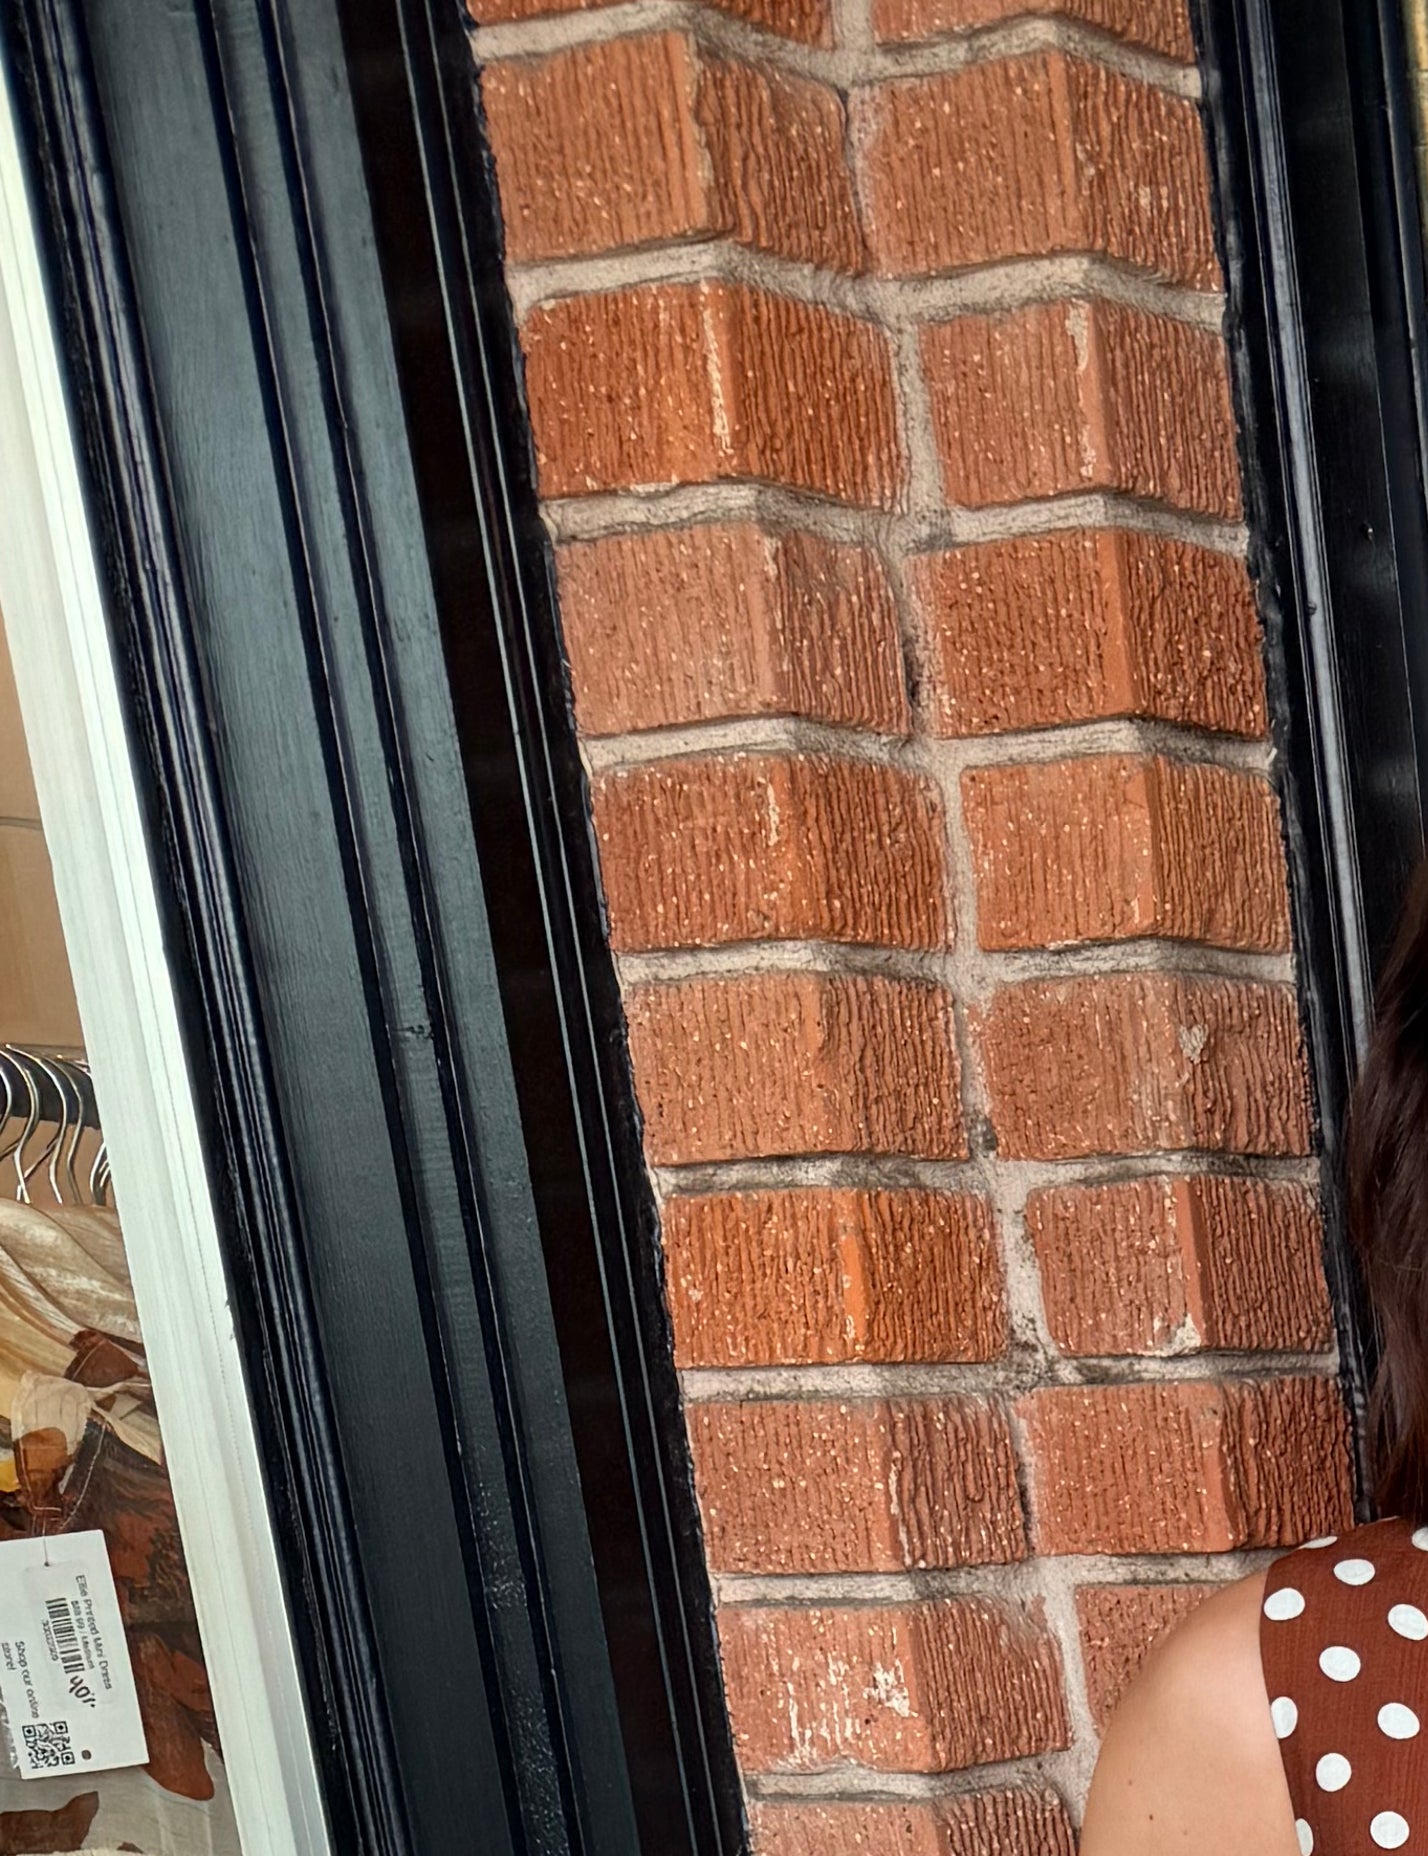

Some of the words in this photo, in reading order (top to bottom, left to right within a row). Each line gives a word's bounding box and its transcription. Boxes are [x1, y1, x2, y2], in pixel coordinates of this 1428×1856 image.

[76, 1574, 88, 1597] Ellie
[84, 1599, 100, 1635] Printed
[15, 1641, 27, 1668] Shop
[93, 1637, 106, 1659] Mini
[21, 1669, 33, 1686] our
[98, 1660, 112, 1690] Dress
[26, 1688, 39, 1719] online
